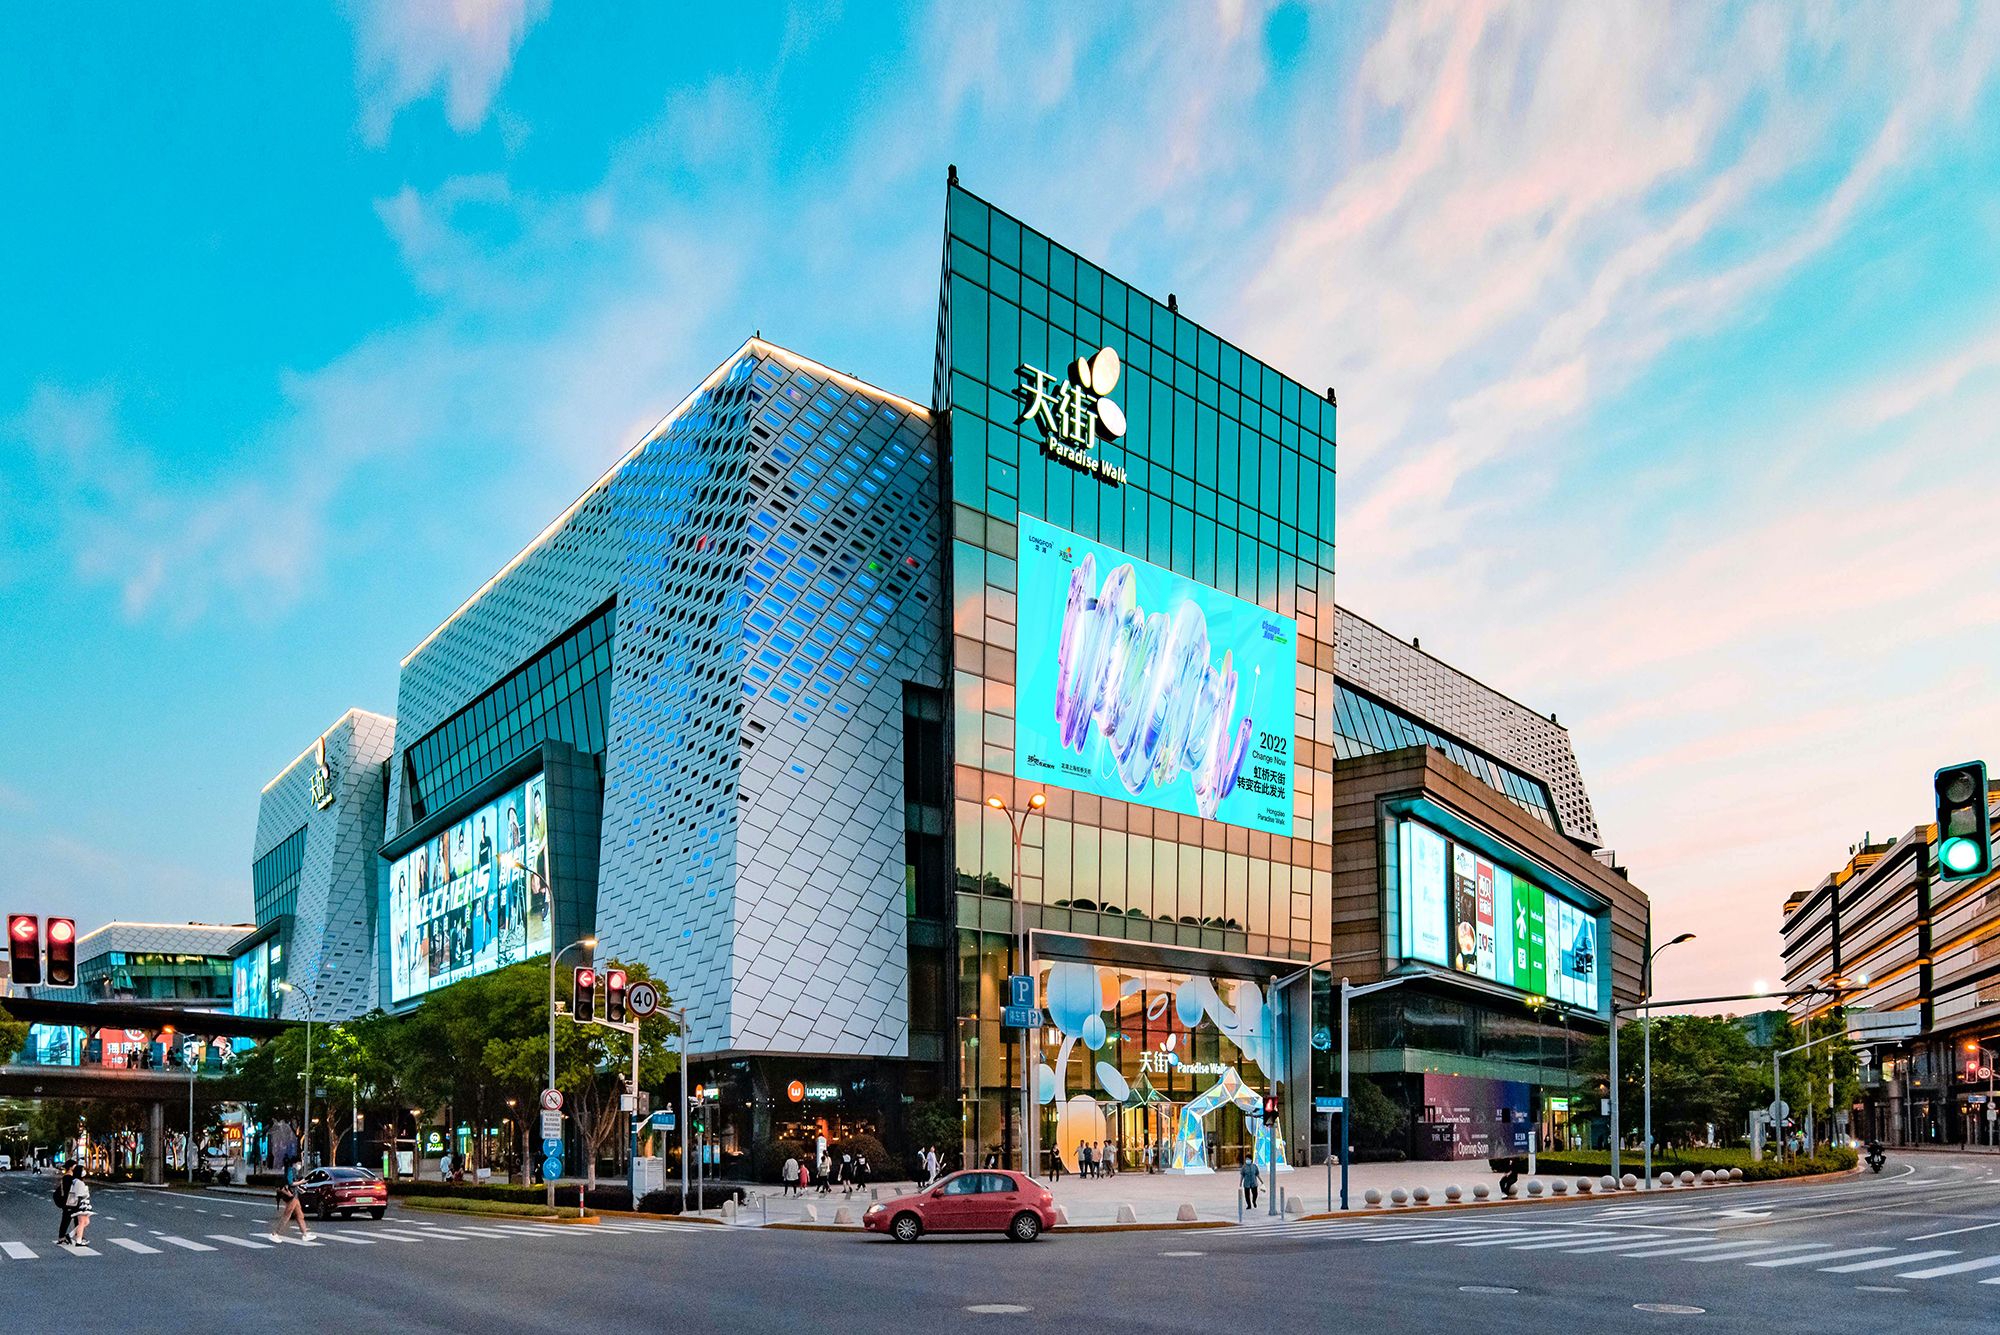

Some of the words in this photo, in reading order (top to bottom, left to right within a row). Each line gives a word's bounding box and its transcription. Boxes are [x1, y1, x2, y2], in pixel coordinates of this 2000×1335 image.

[1021, 363, 1098, 449] 天街
[1049, 436, 1099, 471] Paradise
[1101, 460, 1127, 484] Walk
[1260, 732, 1287, 754] 2022
[1252, 750, 1273, 764] Change
[1274, 755, 1286, 766] Now
[1253, 766, 1286, 785] 虹桥天街
[1237, 776, 1286, 799] 转变在此发光
[633, 991, 652, 1007] 40
[1018, 981, 1029, 1002] P
[1139, 1051, 1169, 1073] 天街
[1177, 1062, 1209, 1074] Paradise
[806, 1088, 837, 1100] wagas
[1458, 1142, 1477, 1157] Opening
[1477, 1142, 1489, 1155] Soon
